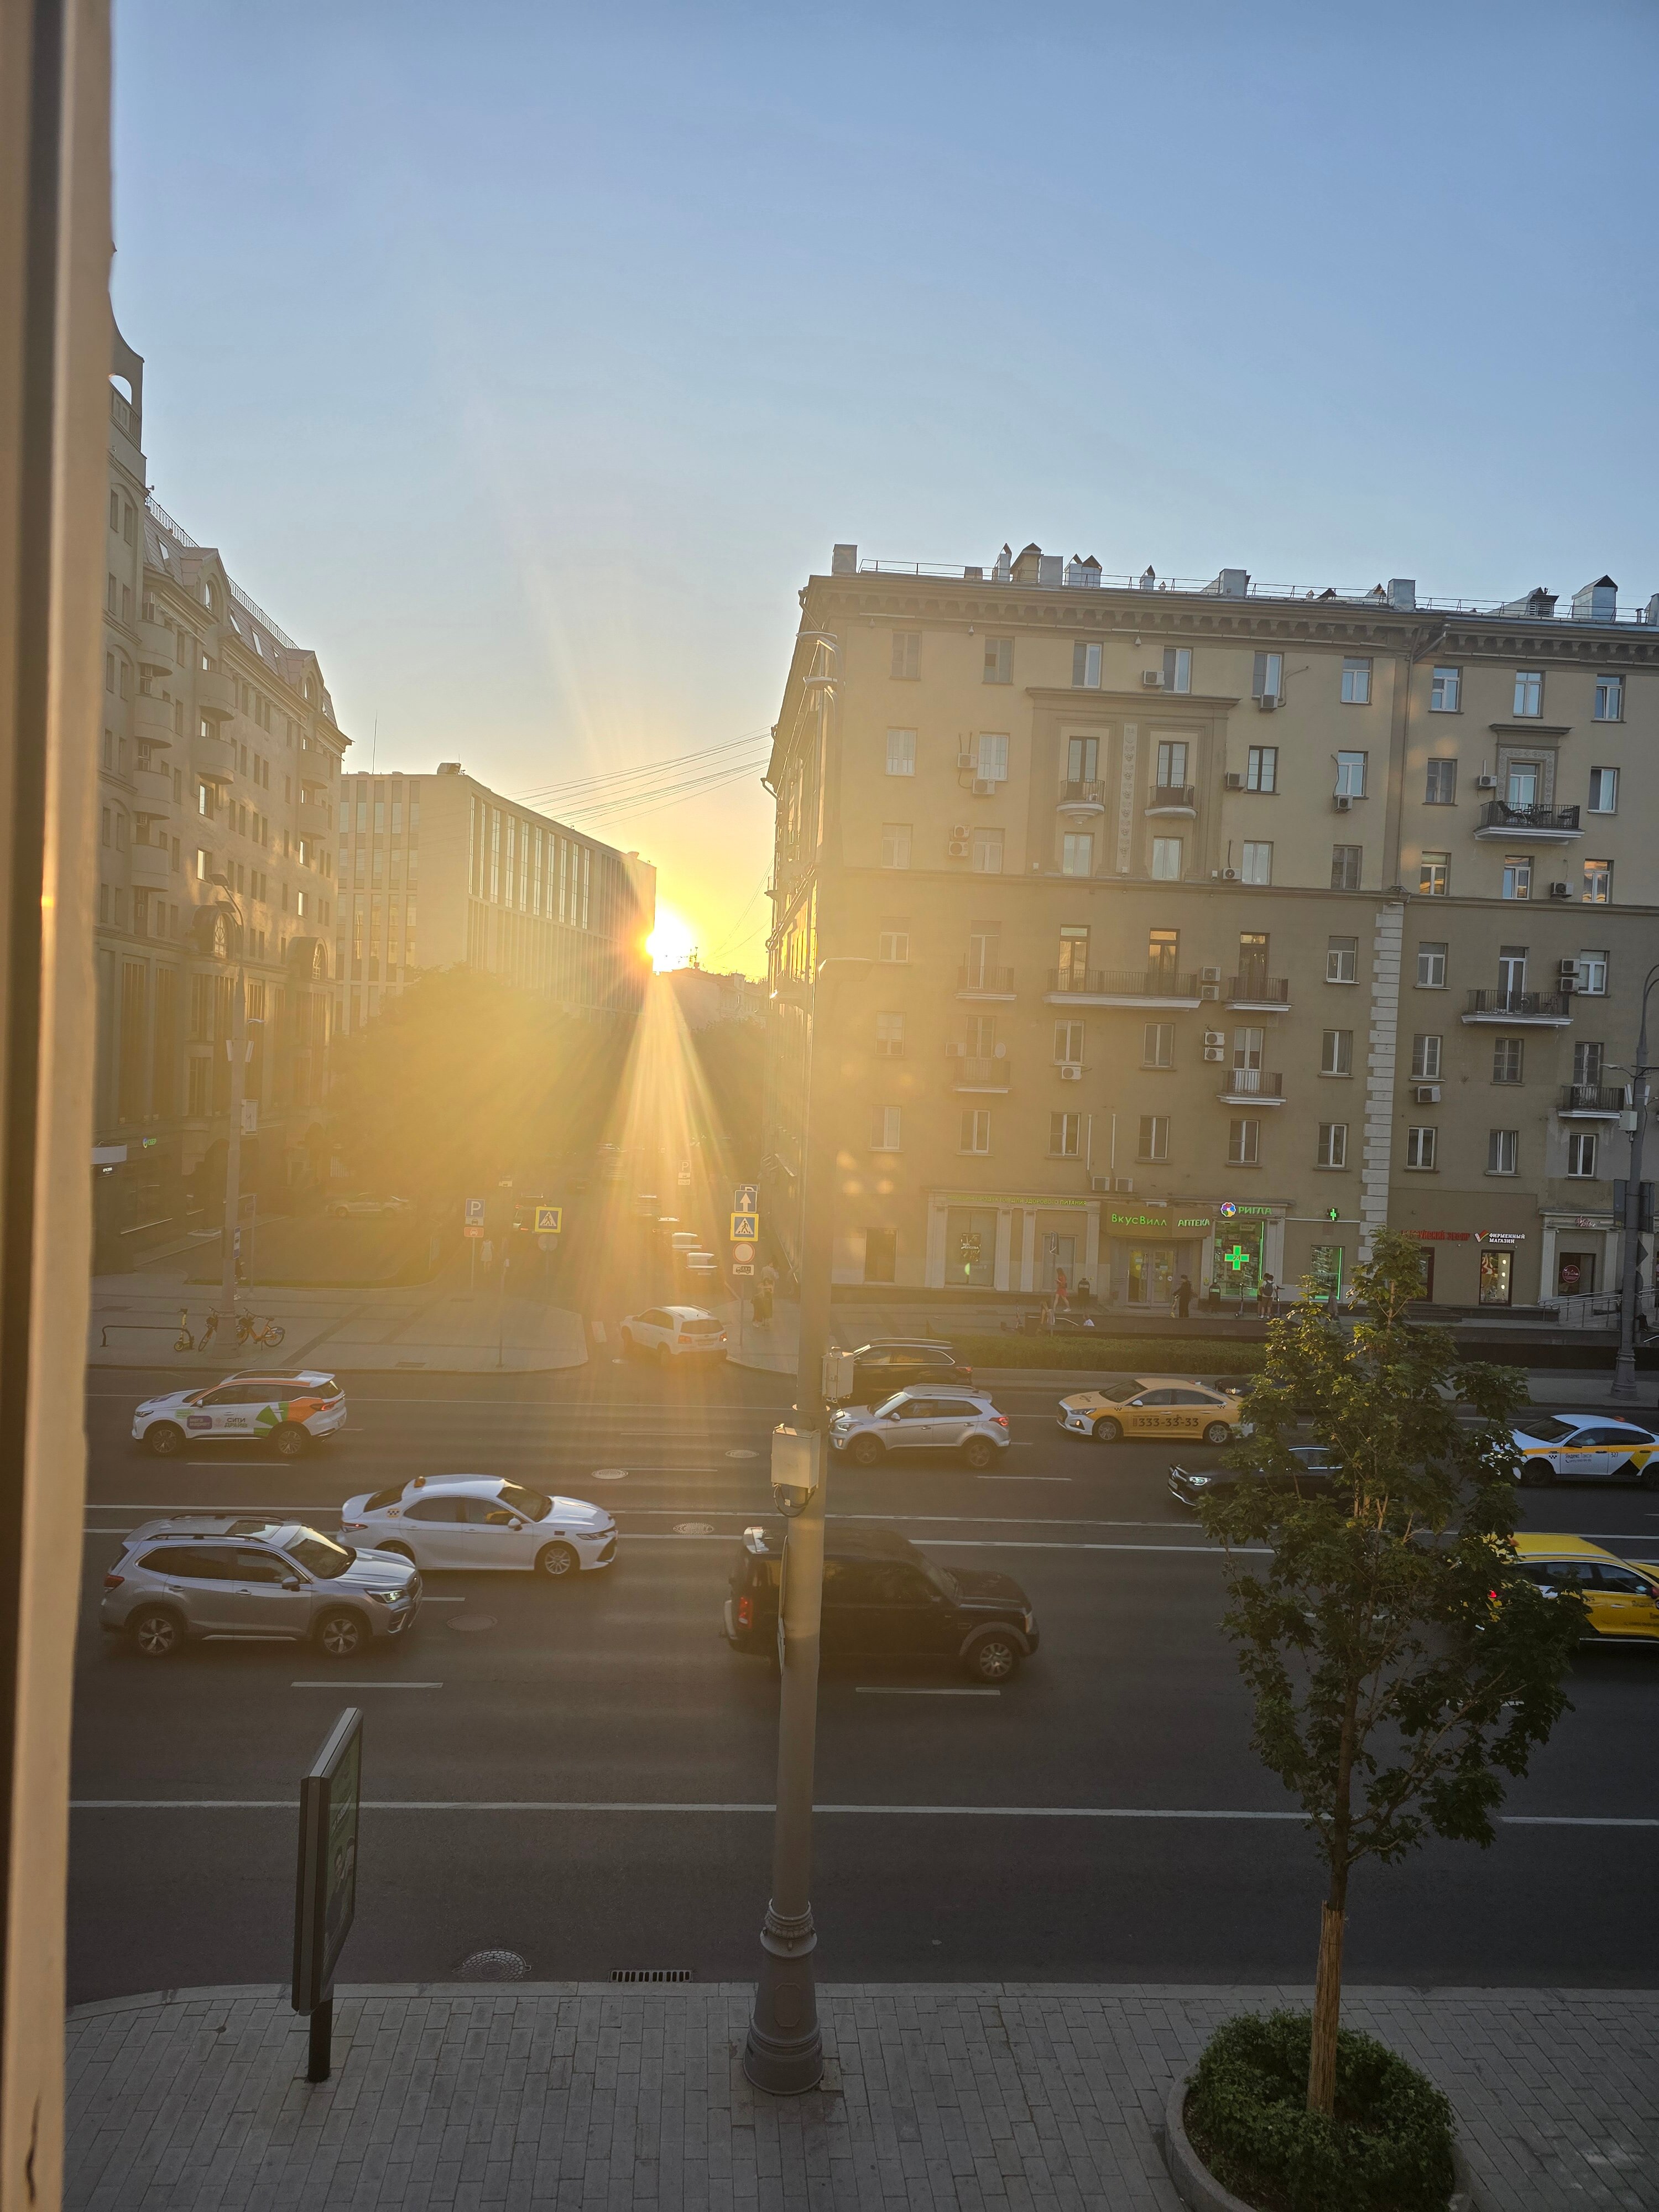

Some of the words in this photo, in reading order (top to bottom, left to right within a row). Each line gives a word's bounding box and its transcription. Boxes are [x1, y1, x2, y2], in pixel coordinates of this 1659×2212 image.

[471, 1201, 481, 1215] P
[1239, 1206, 1272, 1215] РИГЛА
[1178, 1218, 1210, 1227] АПТЕКА
[1139, 1417, 1199, 1427] 333-33-33
